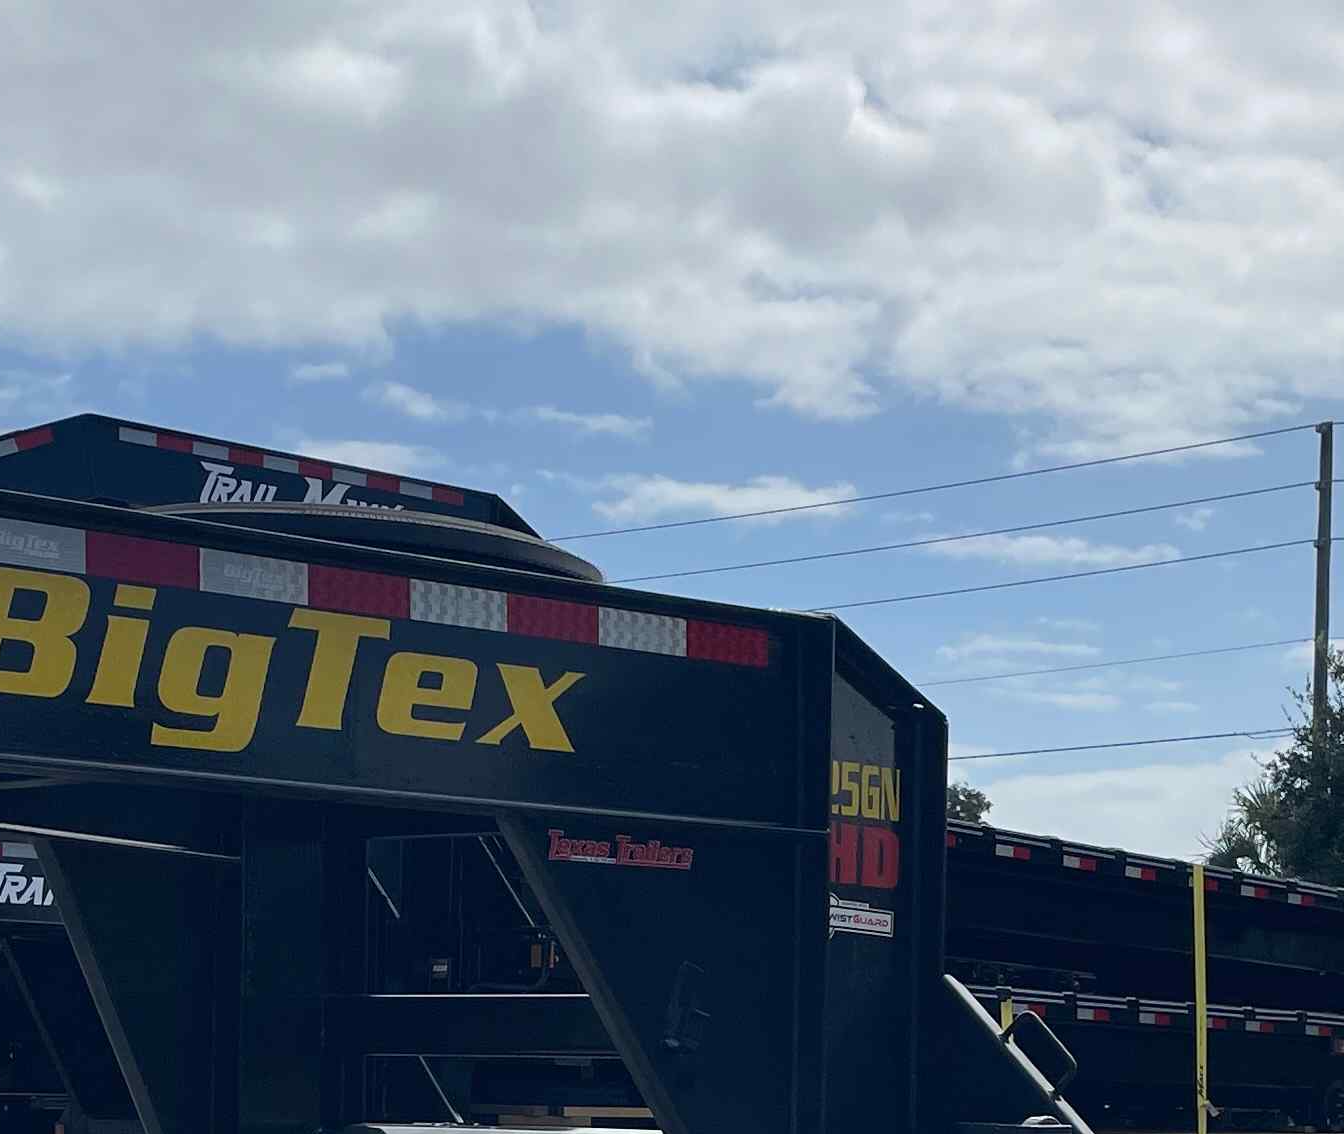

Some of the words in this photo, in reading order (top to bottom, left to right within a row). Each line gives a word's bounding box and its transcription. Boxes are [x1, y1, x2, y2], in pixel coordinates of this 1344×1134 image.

[548, 828, 611, 861] Texas
[616, 834, 693, 870] Trailers
[830, 822, 900, 889] HD
[830, 912, 889, 928] WISTGUARD
